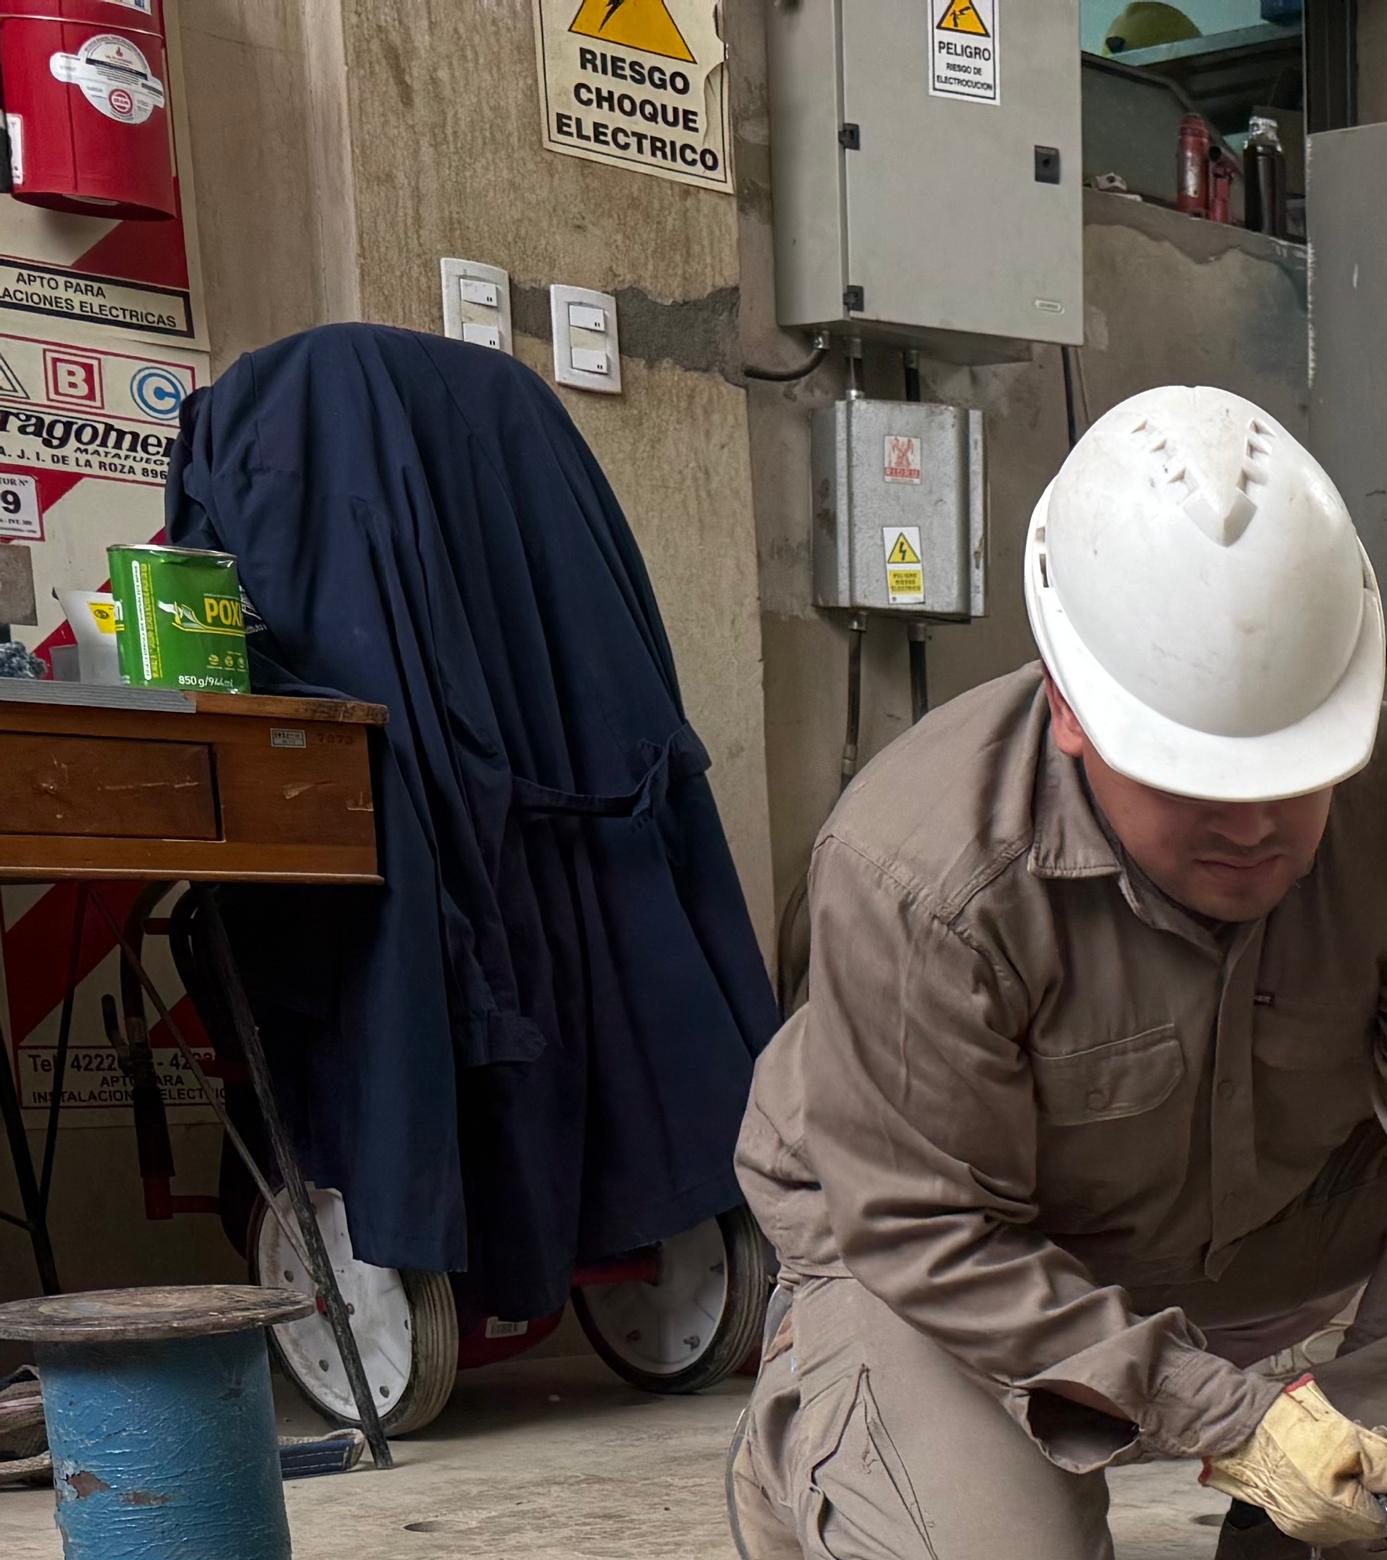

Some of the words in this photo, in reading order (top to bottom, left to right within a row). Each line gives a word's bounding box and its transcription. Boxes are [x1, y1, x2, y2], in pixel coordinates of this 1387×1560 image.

[938, 40, 992, 62] PELIGRO
[579, 46, 690, 96] RIESGO
[946, 62, 970, 75] RIESGO
[972, 66, 982, 76] DE
[936, 75, 993, 92] ELECTROCUCION
[573, 82, 700, 134] CHOQUE
[555, 112, 720, 172] ELECTRICO
[16, 271, 59, 291] APTO
[64, 280, 106, 299] PARA
[0, 287, 75, 311] ACIONES
[79, 301, 177, 328] ELECTRICAS
[56, 361, 89, 397] B
[17, 449, 30, 460] J.
[51, 454, 70, 466] DE
[75, 457, 93, 469] LA
[98, 461, 136, 476] ROZA
[178, 675, 197, 686] 850
[157, 1074, 185, 1087] ARA
